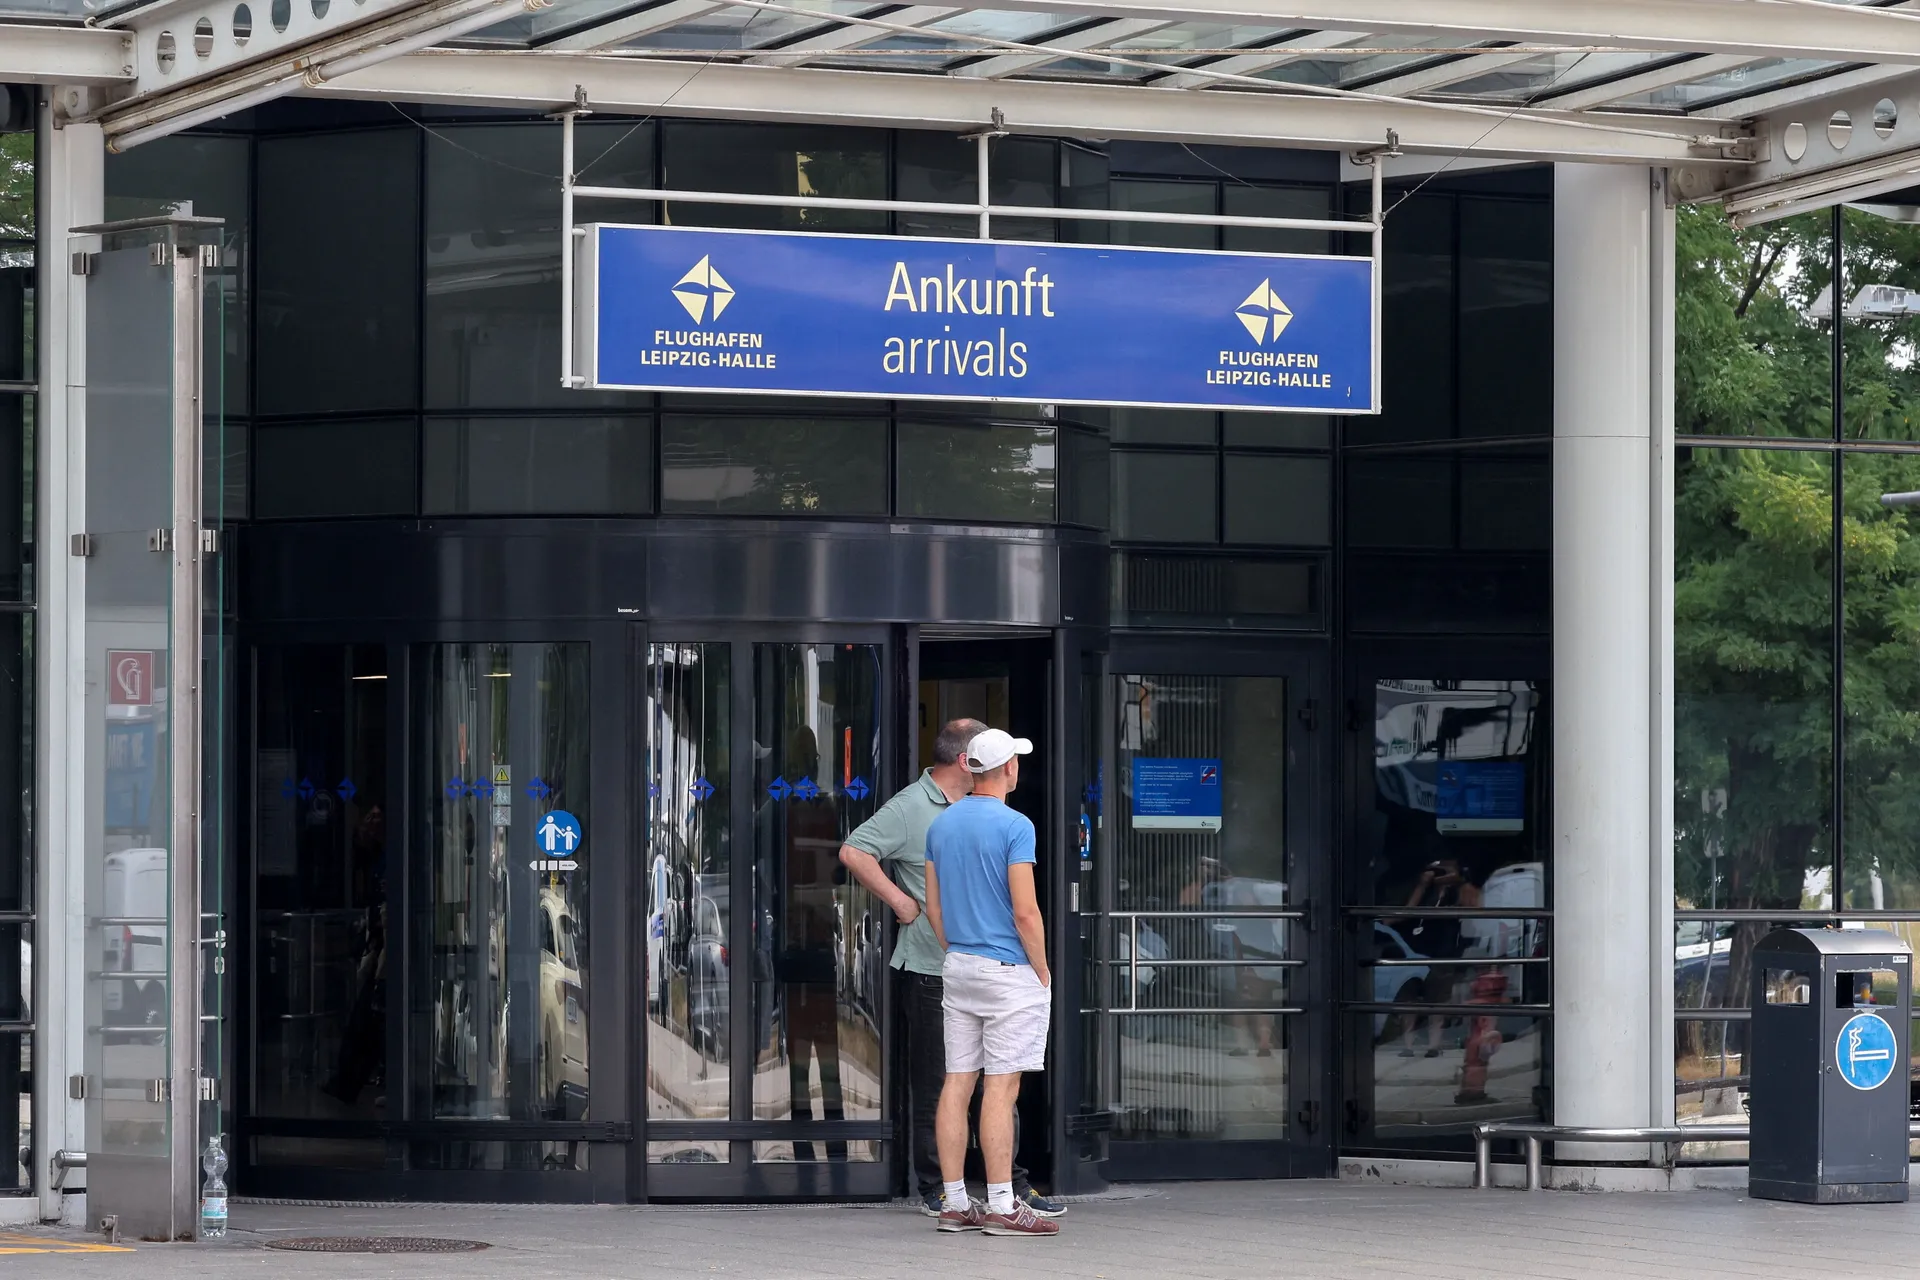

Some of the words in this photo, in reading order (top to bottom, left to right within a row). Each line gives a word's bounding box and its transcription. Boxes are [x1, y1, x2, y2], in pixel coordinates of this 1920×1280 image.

[884, 261, 1055, 318] Ankunft
[654, 330, 763, 349] FLUGHAFEN
[882, 325, 1028, 379] arrivals
[1219, 350, 1319, 369] FLUGHAFEN
